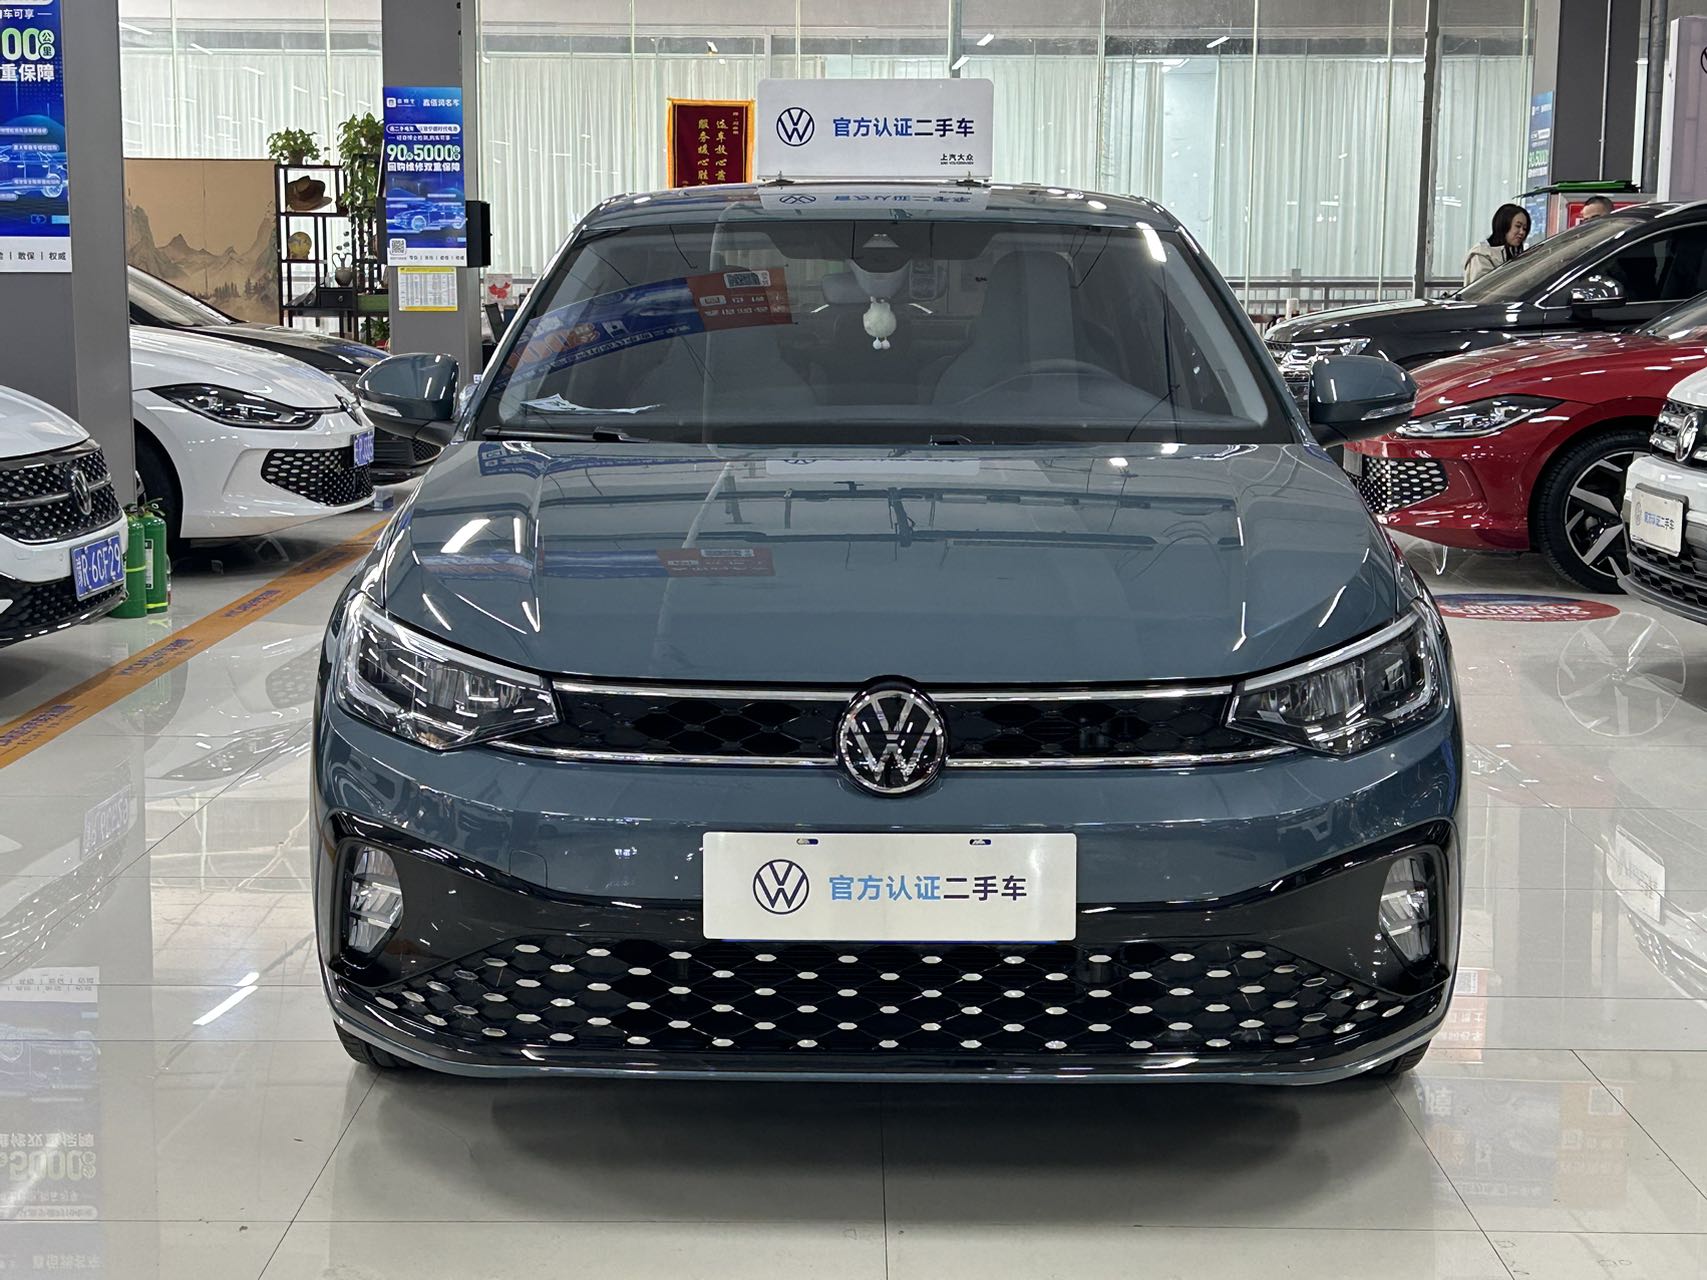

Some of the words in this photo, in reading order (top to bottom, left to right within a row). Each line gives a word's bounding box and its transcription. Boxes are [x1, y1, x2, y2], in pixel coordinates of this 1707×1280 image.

[0, 8, 35, 19] 车可享
[833, 117, 974, 137] 官方认证二手车
[940, 153, 974, 162] 上汽大众
[829, 875, 1027, 901] 官方认证二手车
